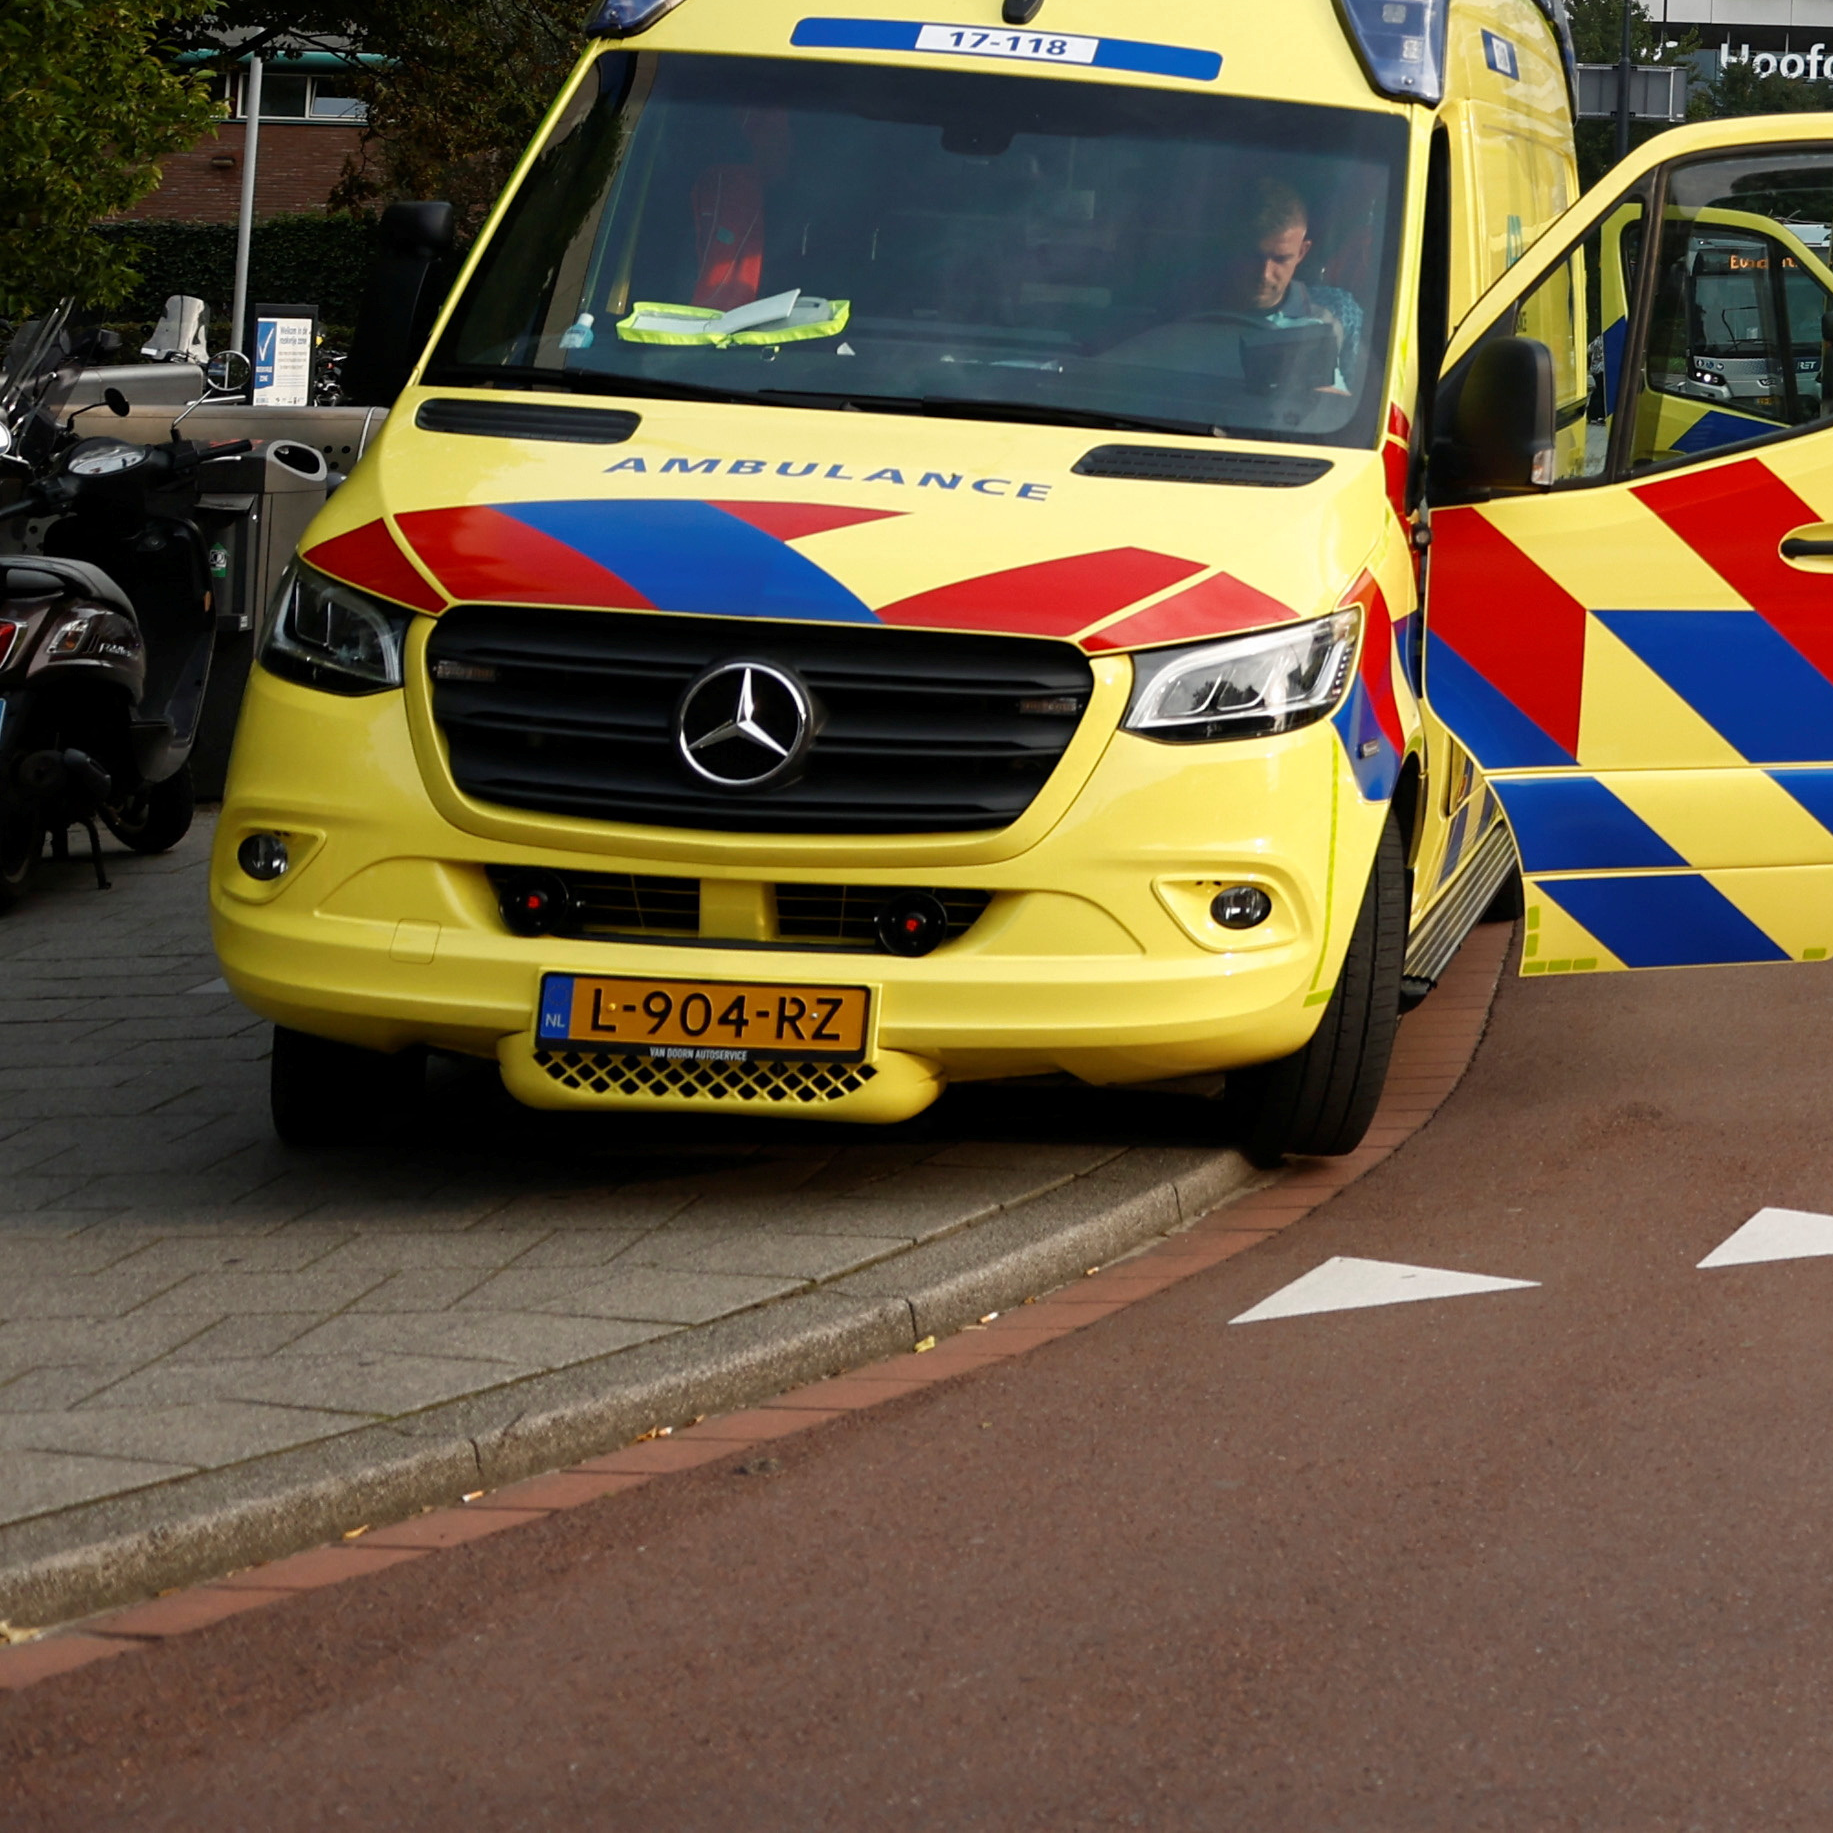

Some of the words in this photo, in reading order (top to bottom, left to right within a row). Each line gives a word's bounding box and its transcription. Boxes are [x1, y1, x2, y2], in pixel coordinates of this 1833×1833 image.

[949, 31, 1068, 55] 17-118
[602, 456, 1054, 502] AMBULANCE
[545, 1013, 565, 1028] NL
[590, 987, 844, 1042] L-904-RZ
[650, 1046, 666, 1057] VAN
[667, 1047, 694, 1059] DOORN
[694, 1049, 748, 1061] AUTOSERVICE
